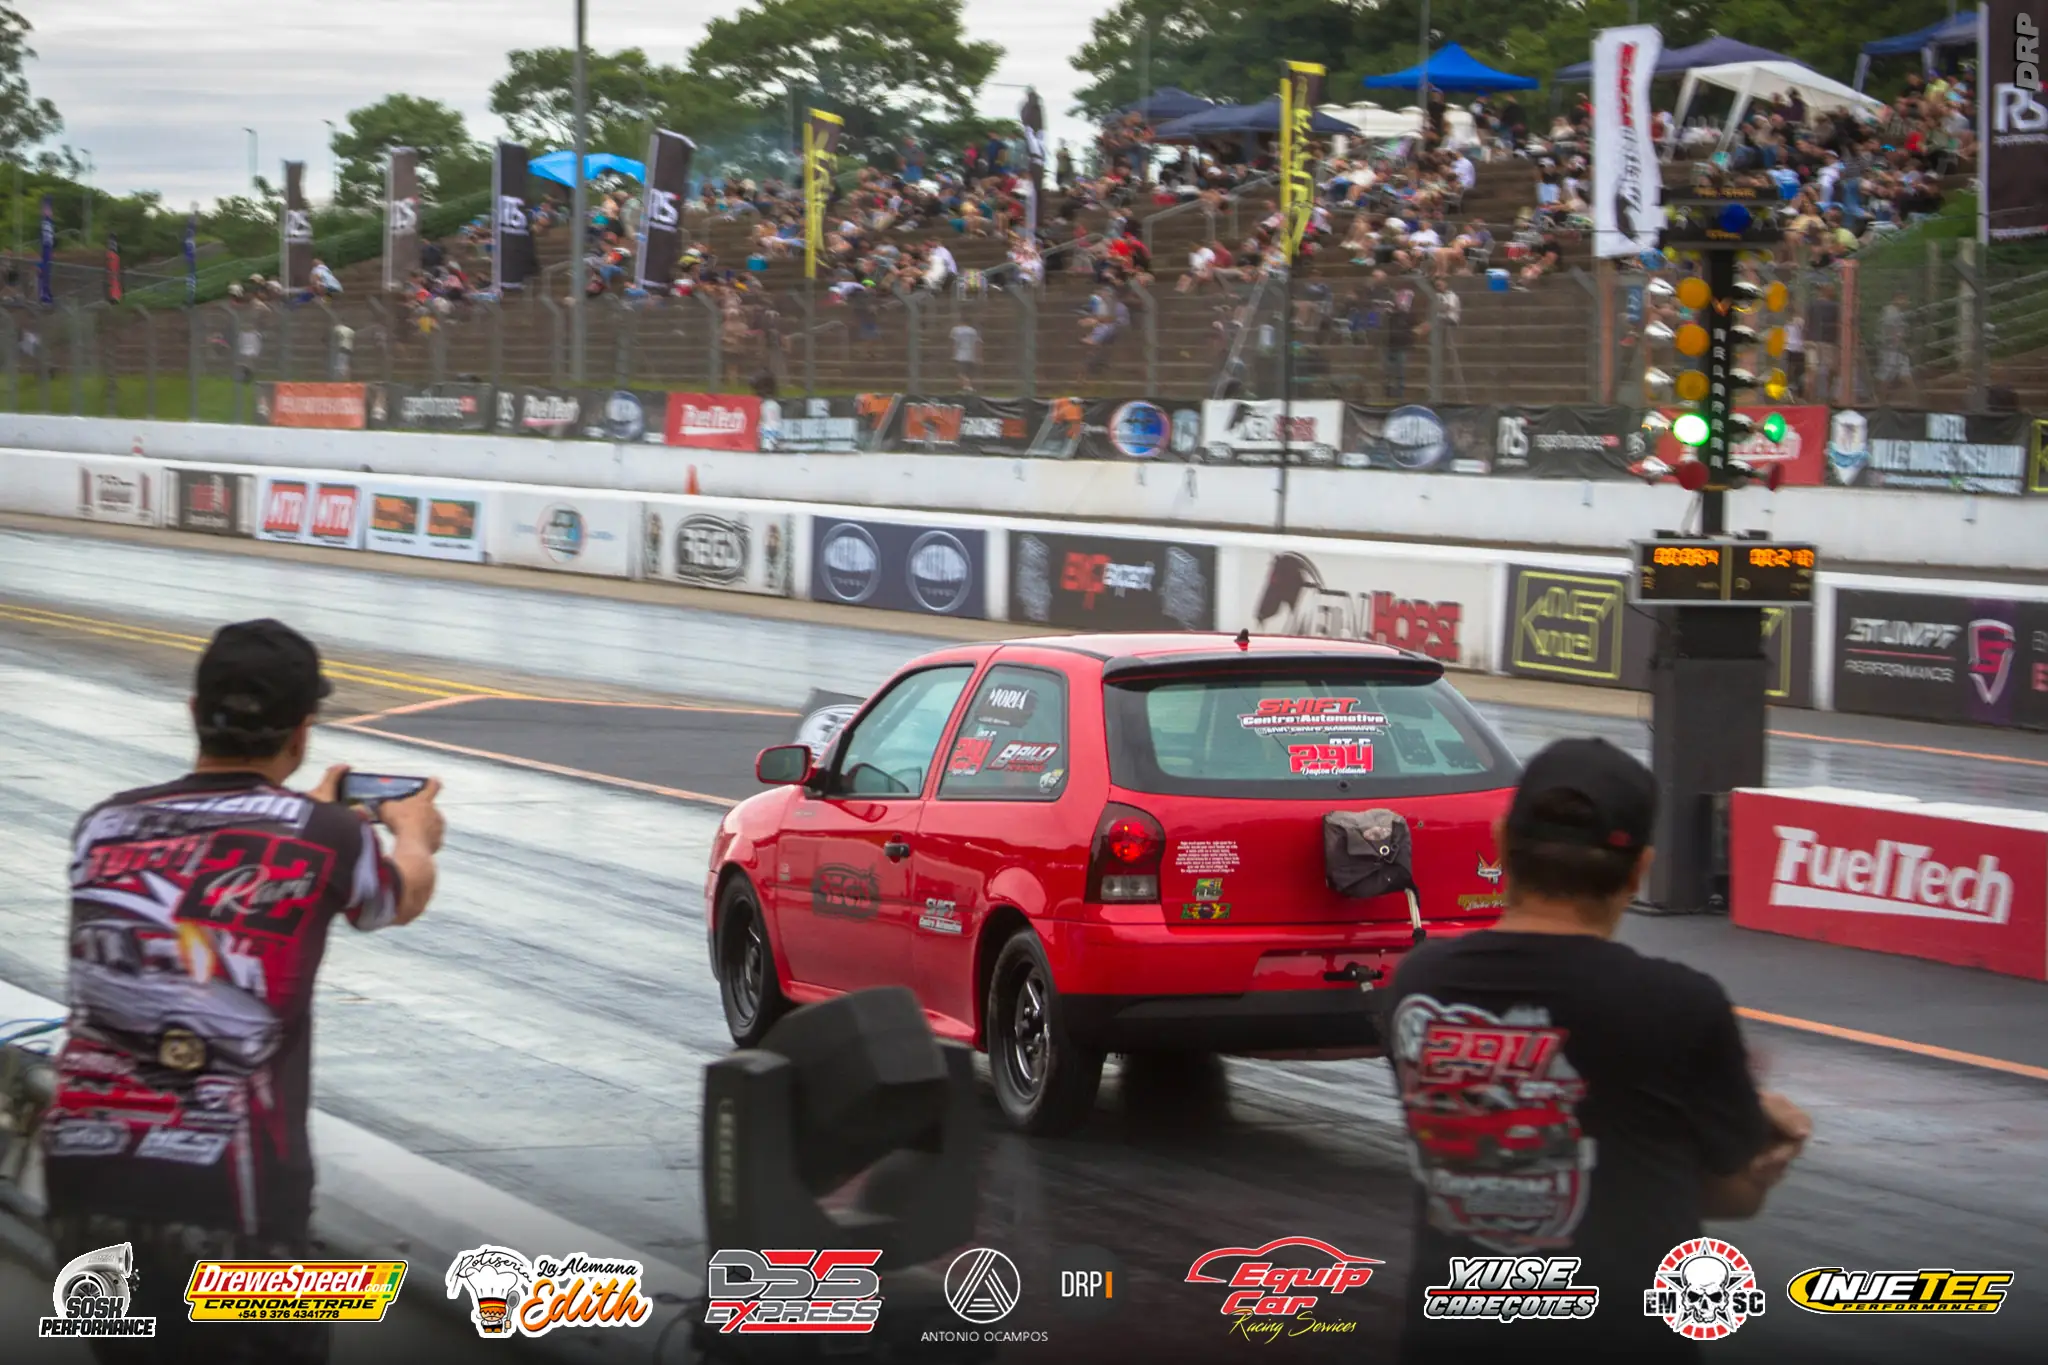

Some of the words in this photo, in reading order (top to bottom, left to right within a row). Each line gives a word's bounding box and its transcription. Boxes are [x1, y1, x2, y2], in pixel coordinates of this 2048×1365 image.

[1845, 617, 1963, 649] STUMPF
[1844, 659, 1955, 683] PERFORMANCE
[1243, 715, 1294, 725] Centro
[1300, 714, 1384, 724] Automotivo
[1257, 698, 1357, 715] SHIFT
[1288, 744, 1374, 773] 294
[1772, 825, 2013, 925] FuelTech
